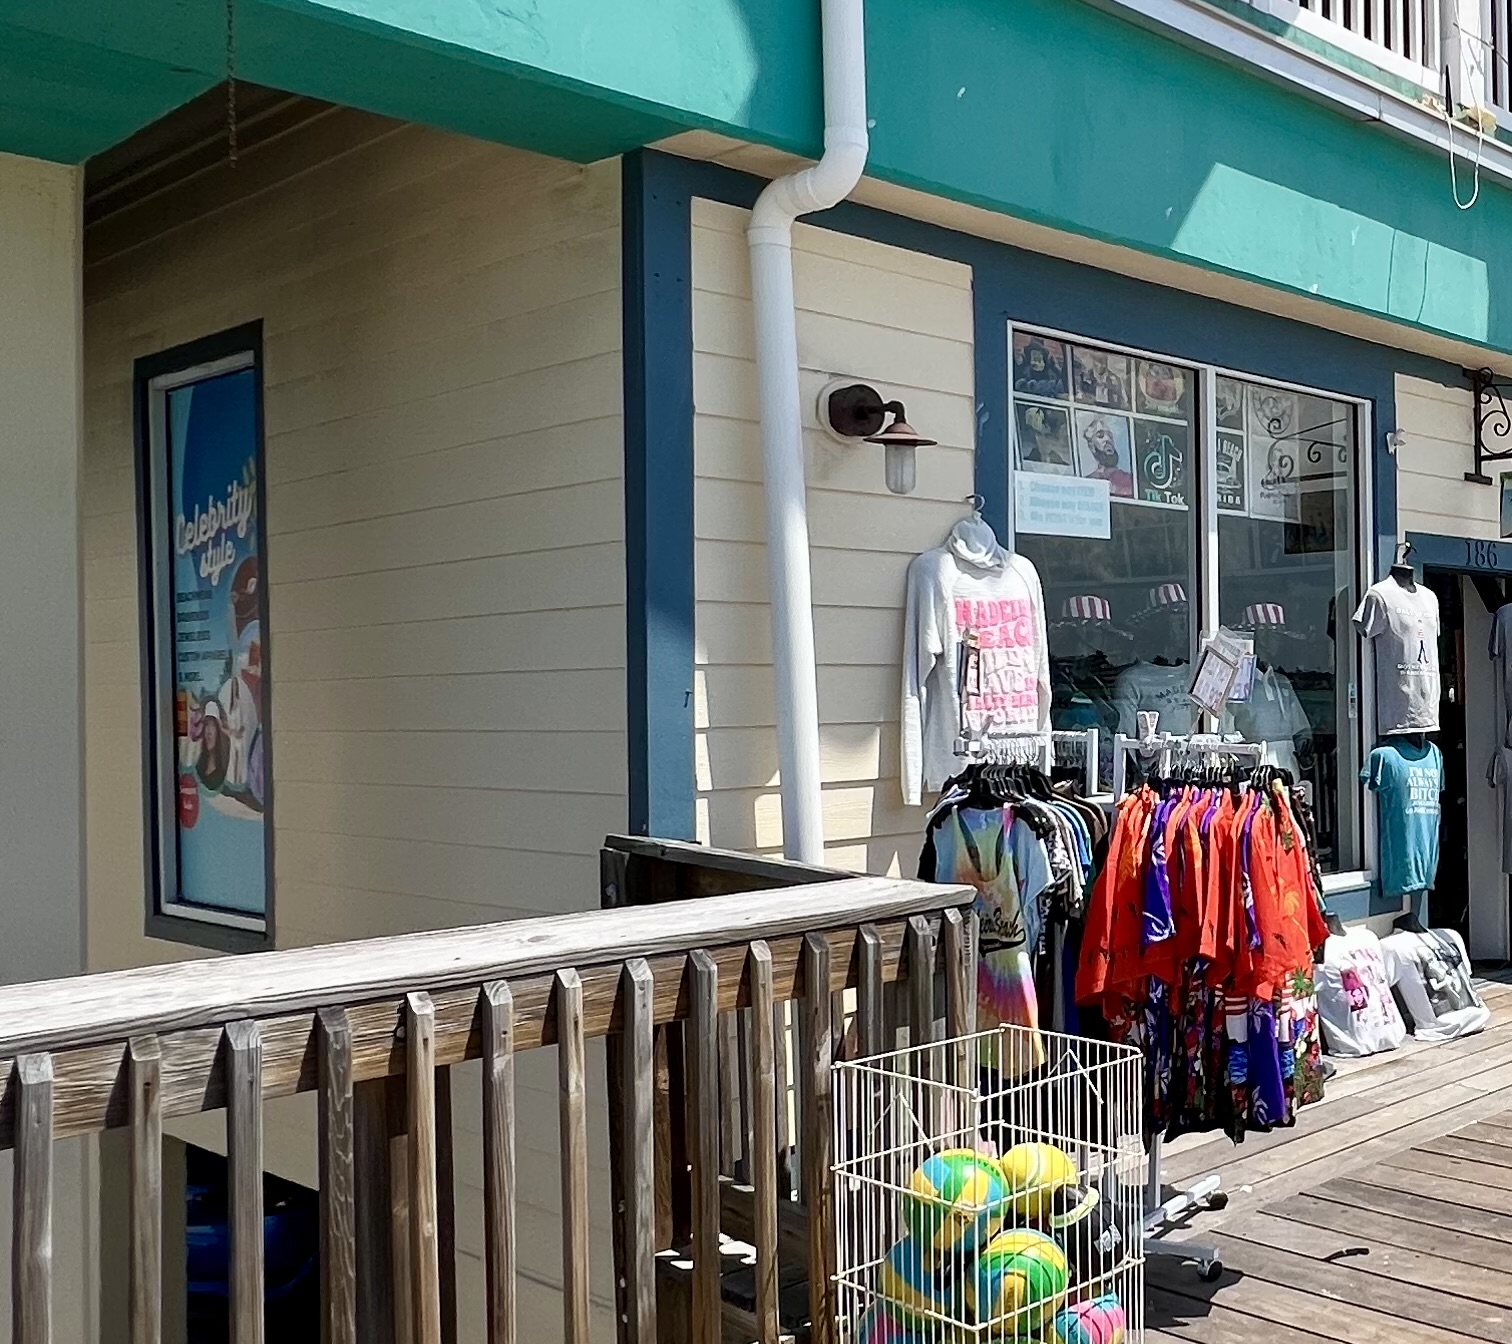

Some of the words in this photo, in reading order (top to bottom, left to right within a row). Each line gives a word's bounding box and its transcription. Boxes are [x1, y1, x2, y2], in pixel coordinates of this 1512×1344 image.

[176, 480, 254, 554] Celebrity
[1164, 491, 1185, 505] Tok
[199, 533, 236, 586] style
[1465, 540, 1498, 568] 186
